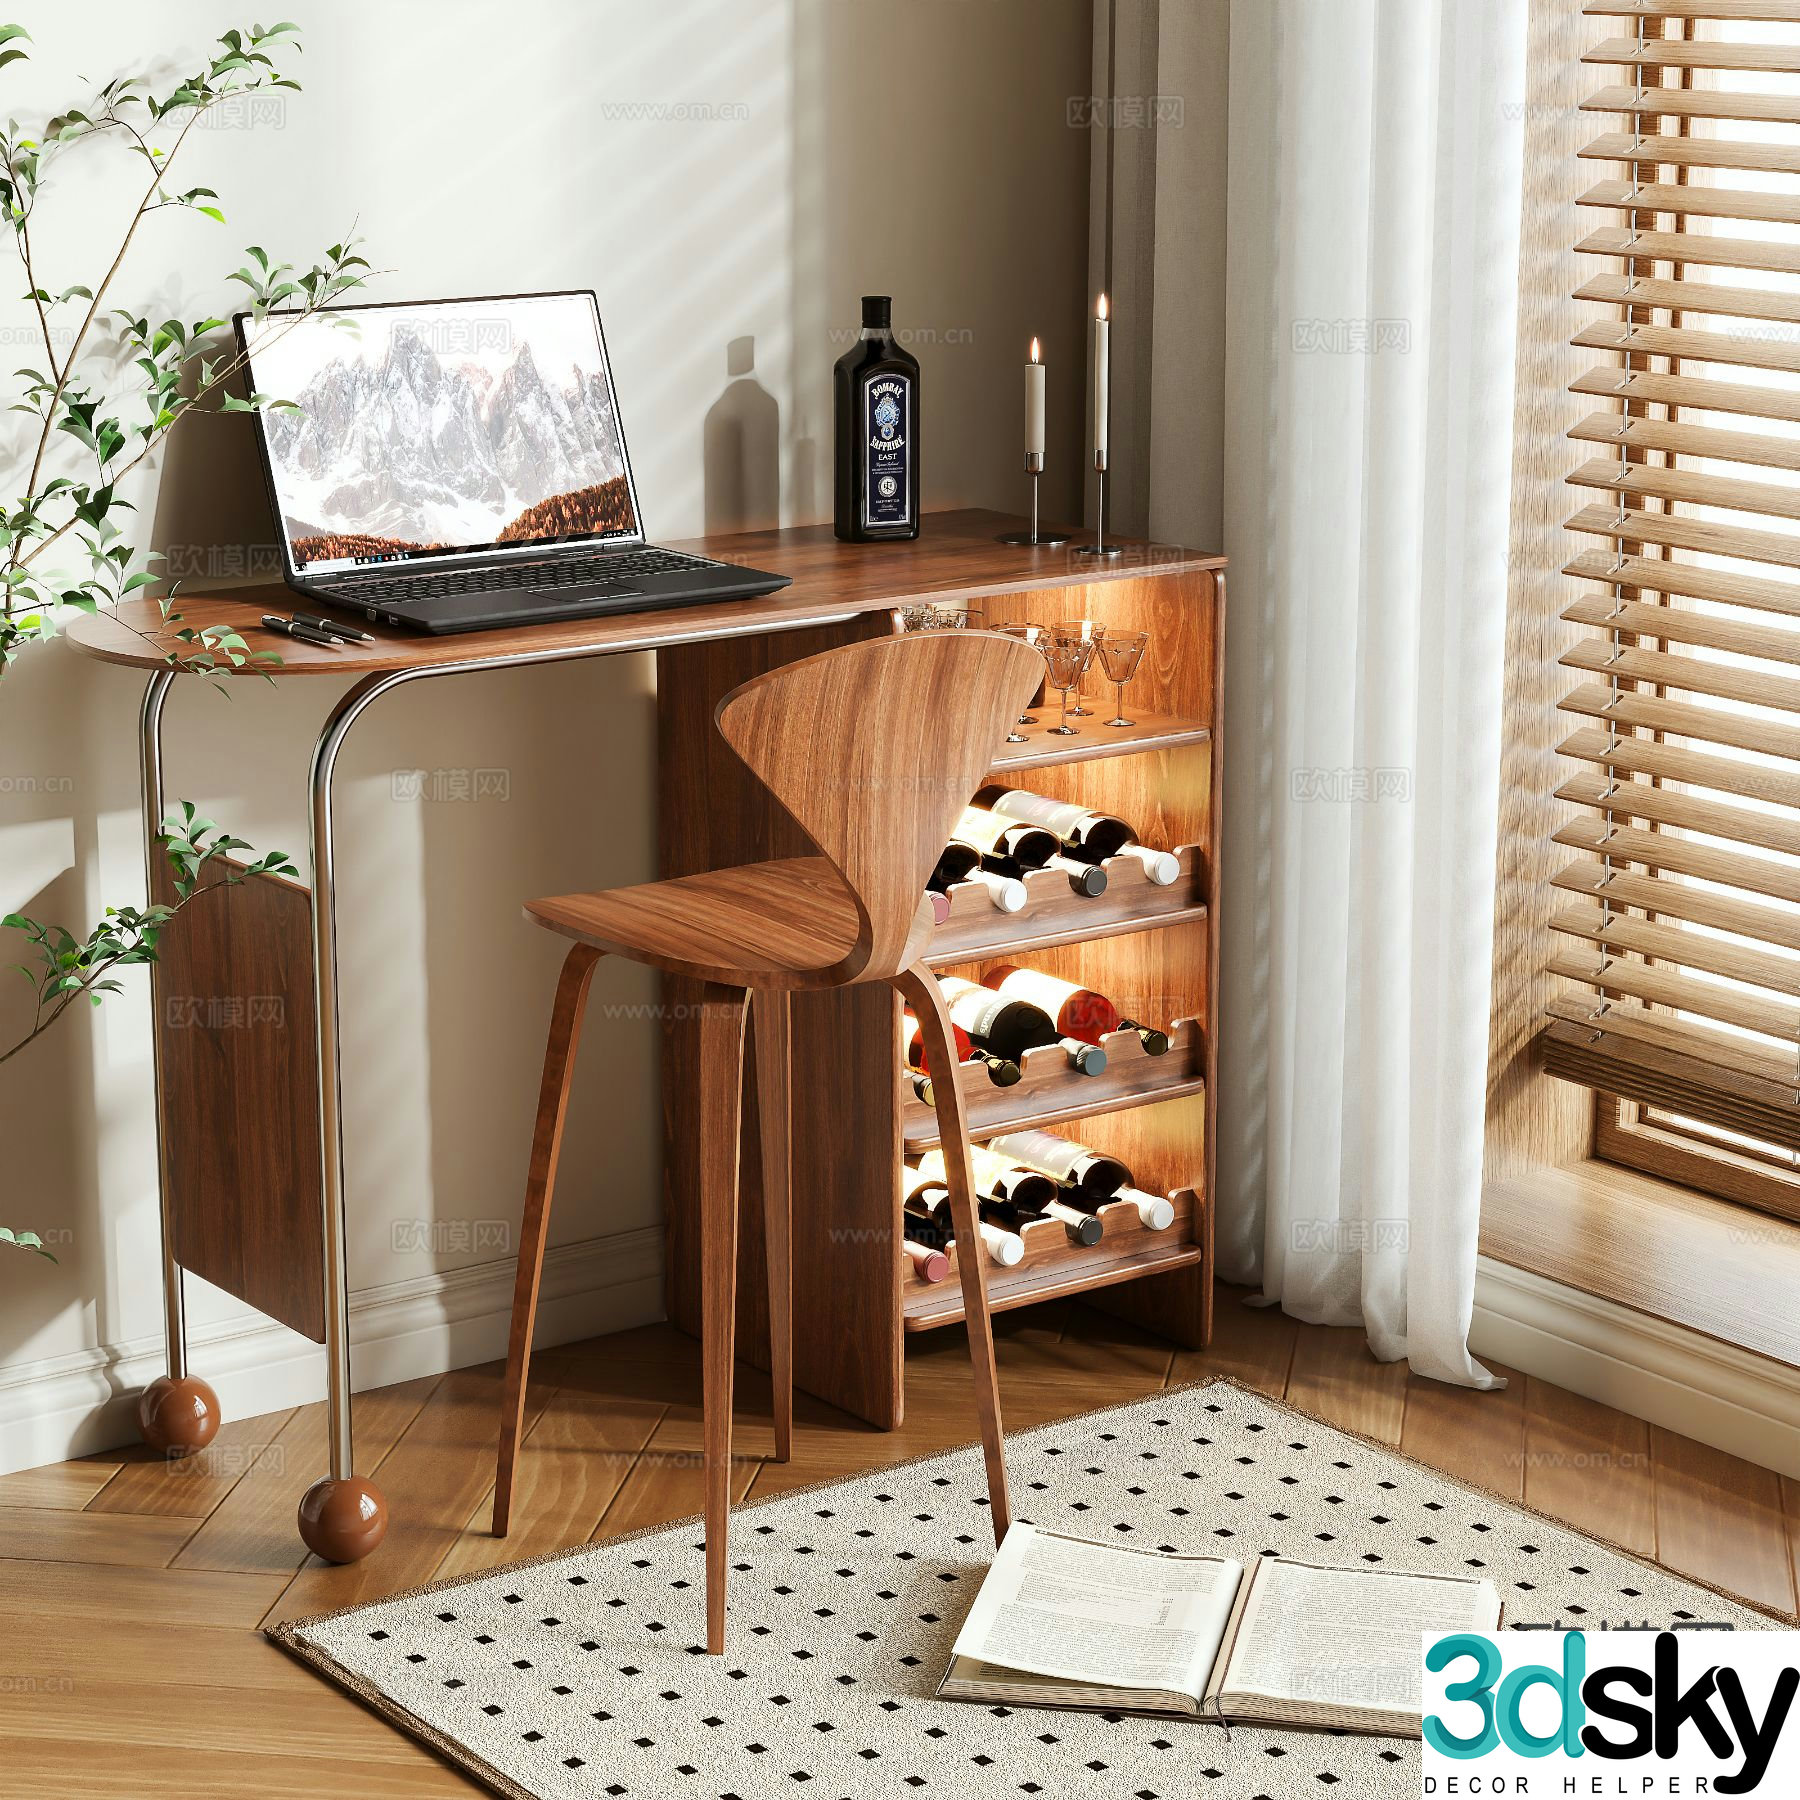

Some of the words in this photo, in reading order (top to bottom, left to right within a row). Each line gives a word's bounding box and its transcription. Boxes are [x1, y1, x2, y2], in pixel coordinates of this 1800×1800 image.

[871, 382, 904, 399] BOMBAY
[870, 435, 906, 452] SAPPHIRE
[878, 453, 897, 461] EAST
